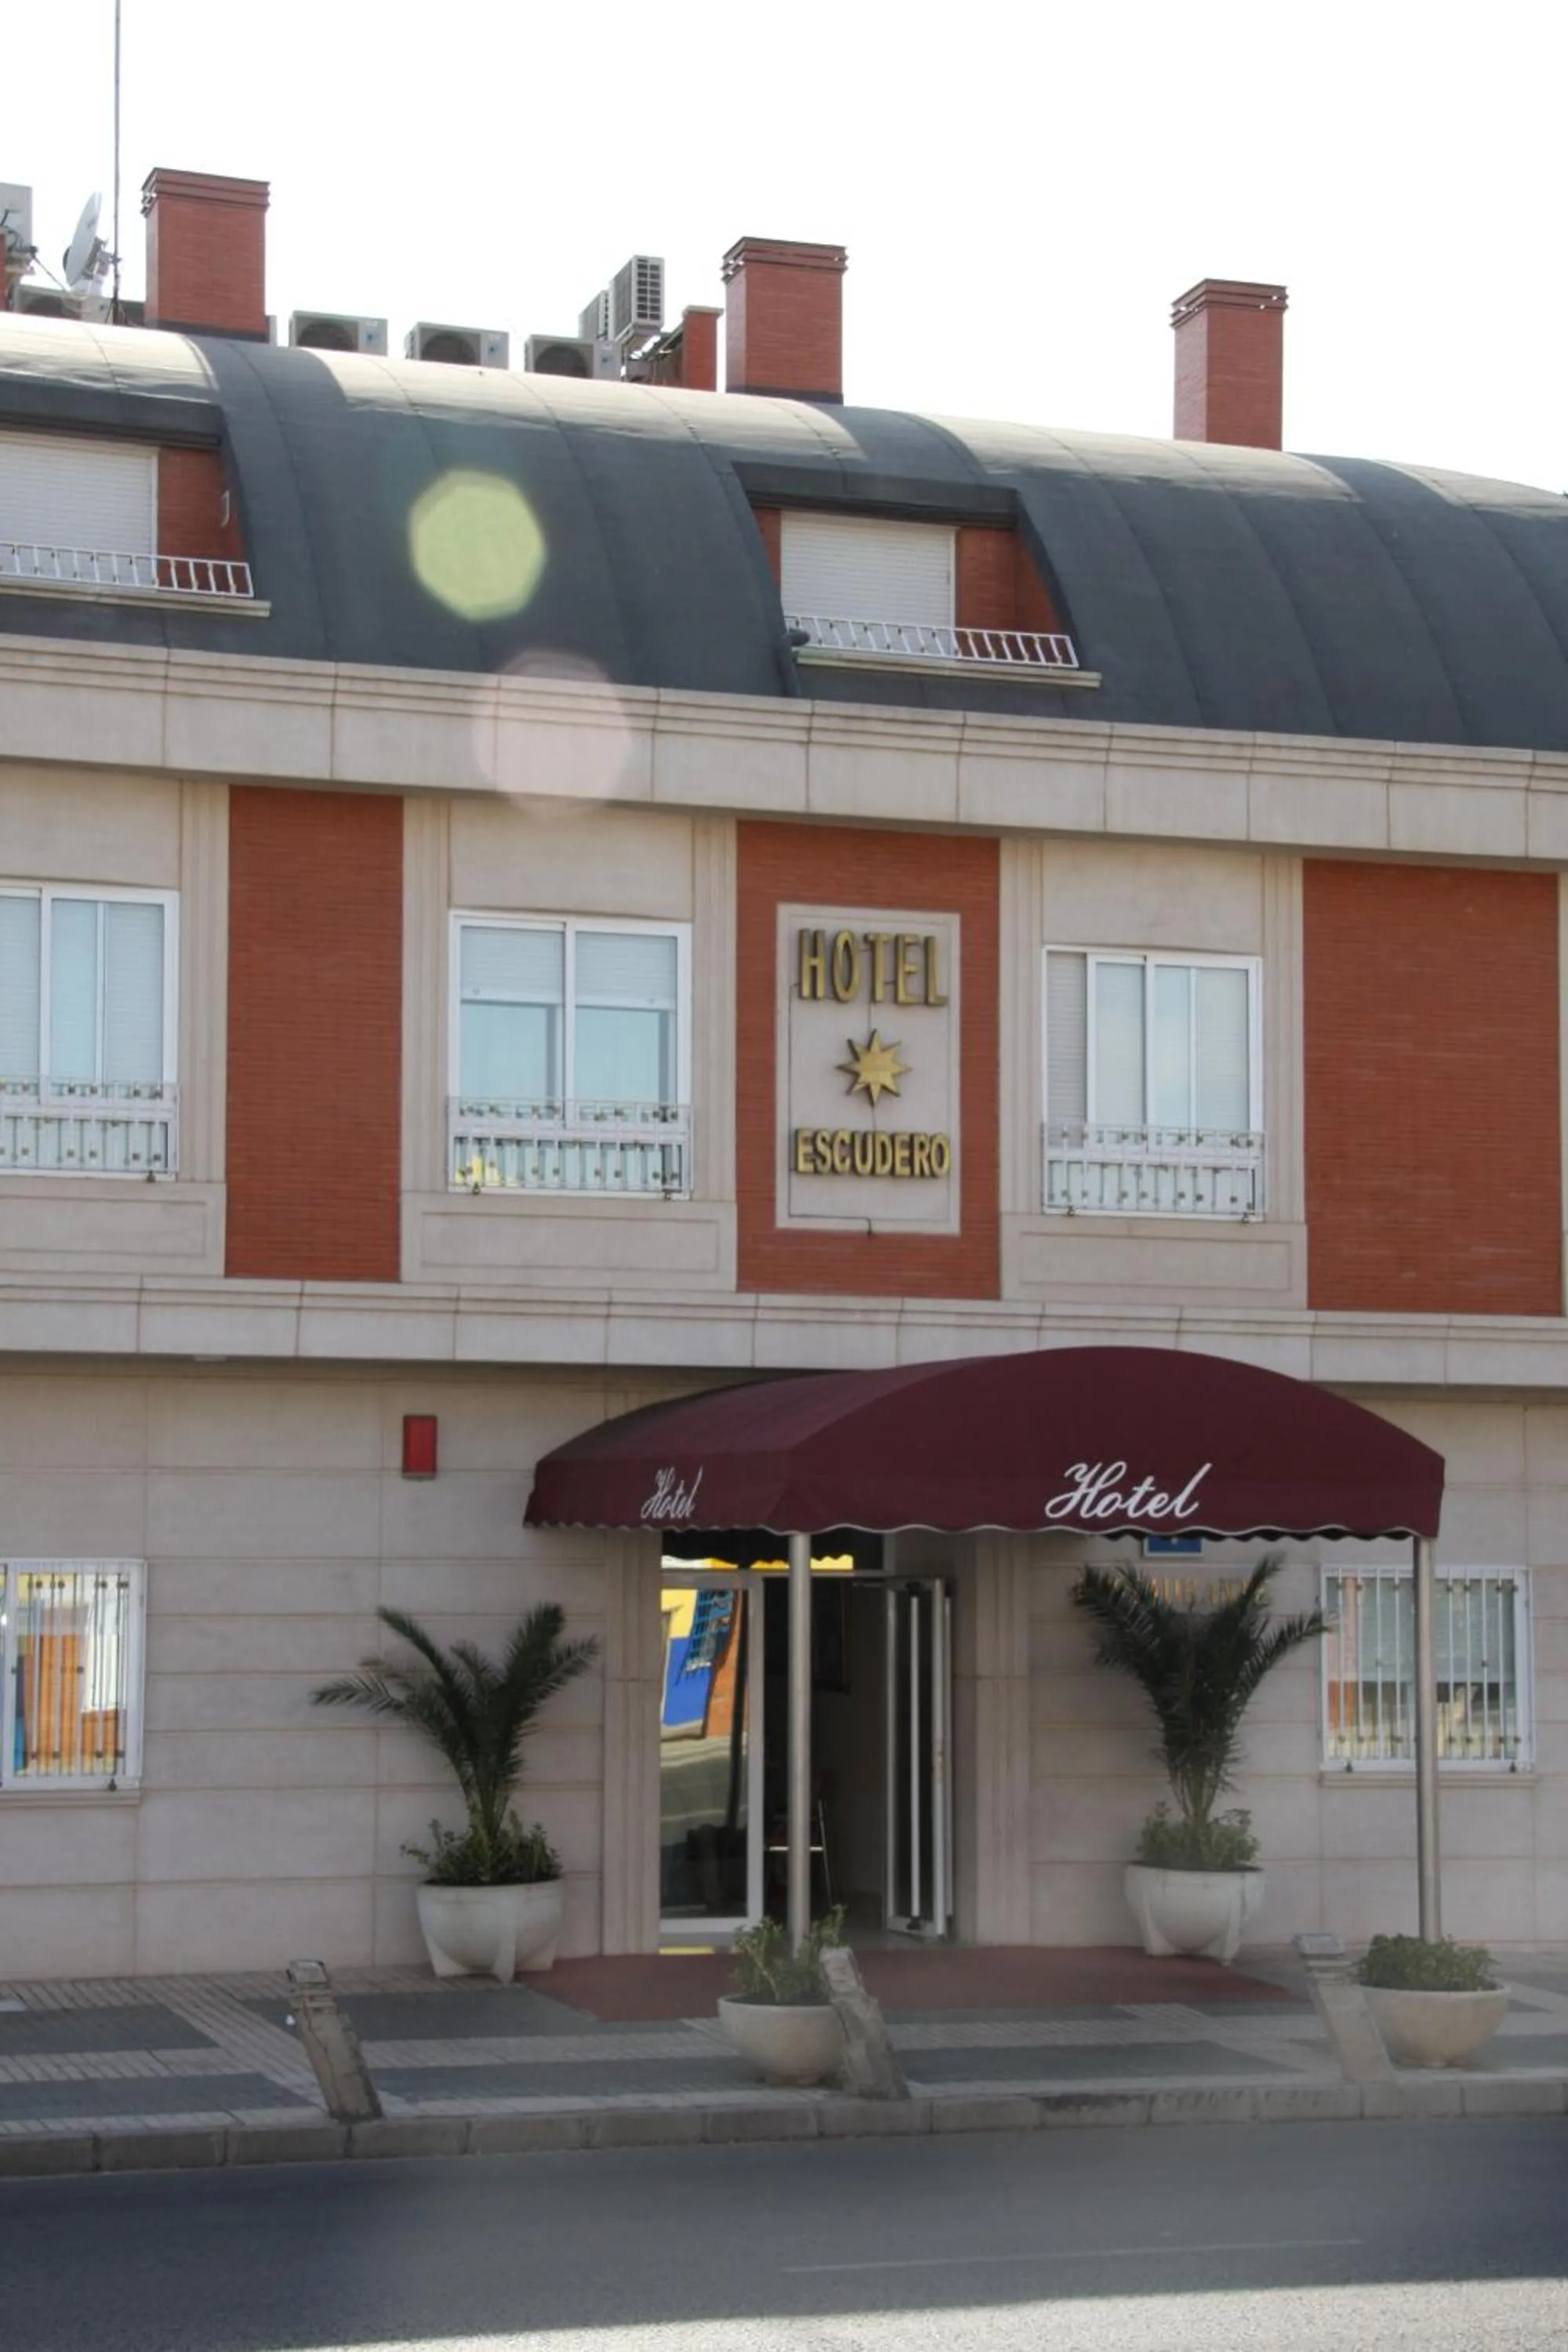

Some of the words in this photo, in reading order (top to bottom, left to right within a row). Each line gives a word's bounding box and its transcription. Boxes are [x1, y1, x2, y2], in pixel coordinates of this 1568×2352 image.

[798, 927, 948, 1006] HOTEL
[794, 1127, 951, 1178] ESCUDERO
[641, 1465, 703, 1519] Hotel
[1044, 1461, 1213, 1518] Hotel
